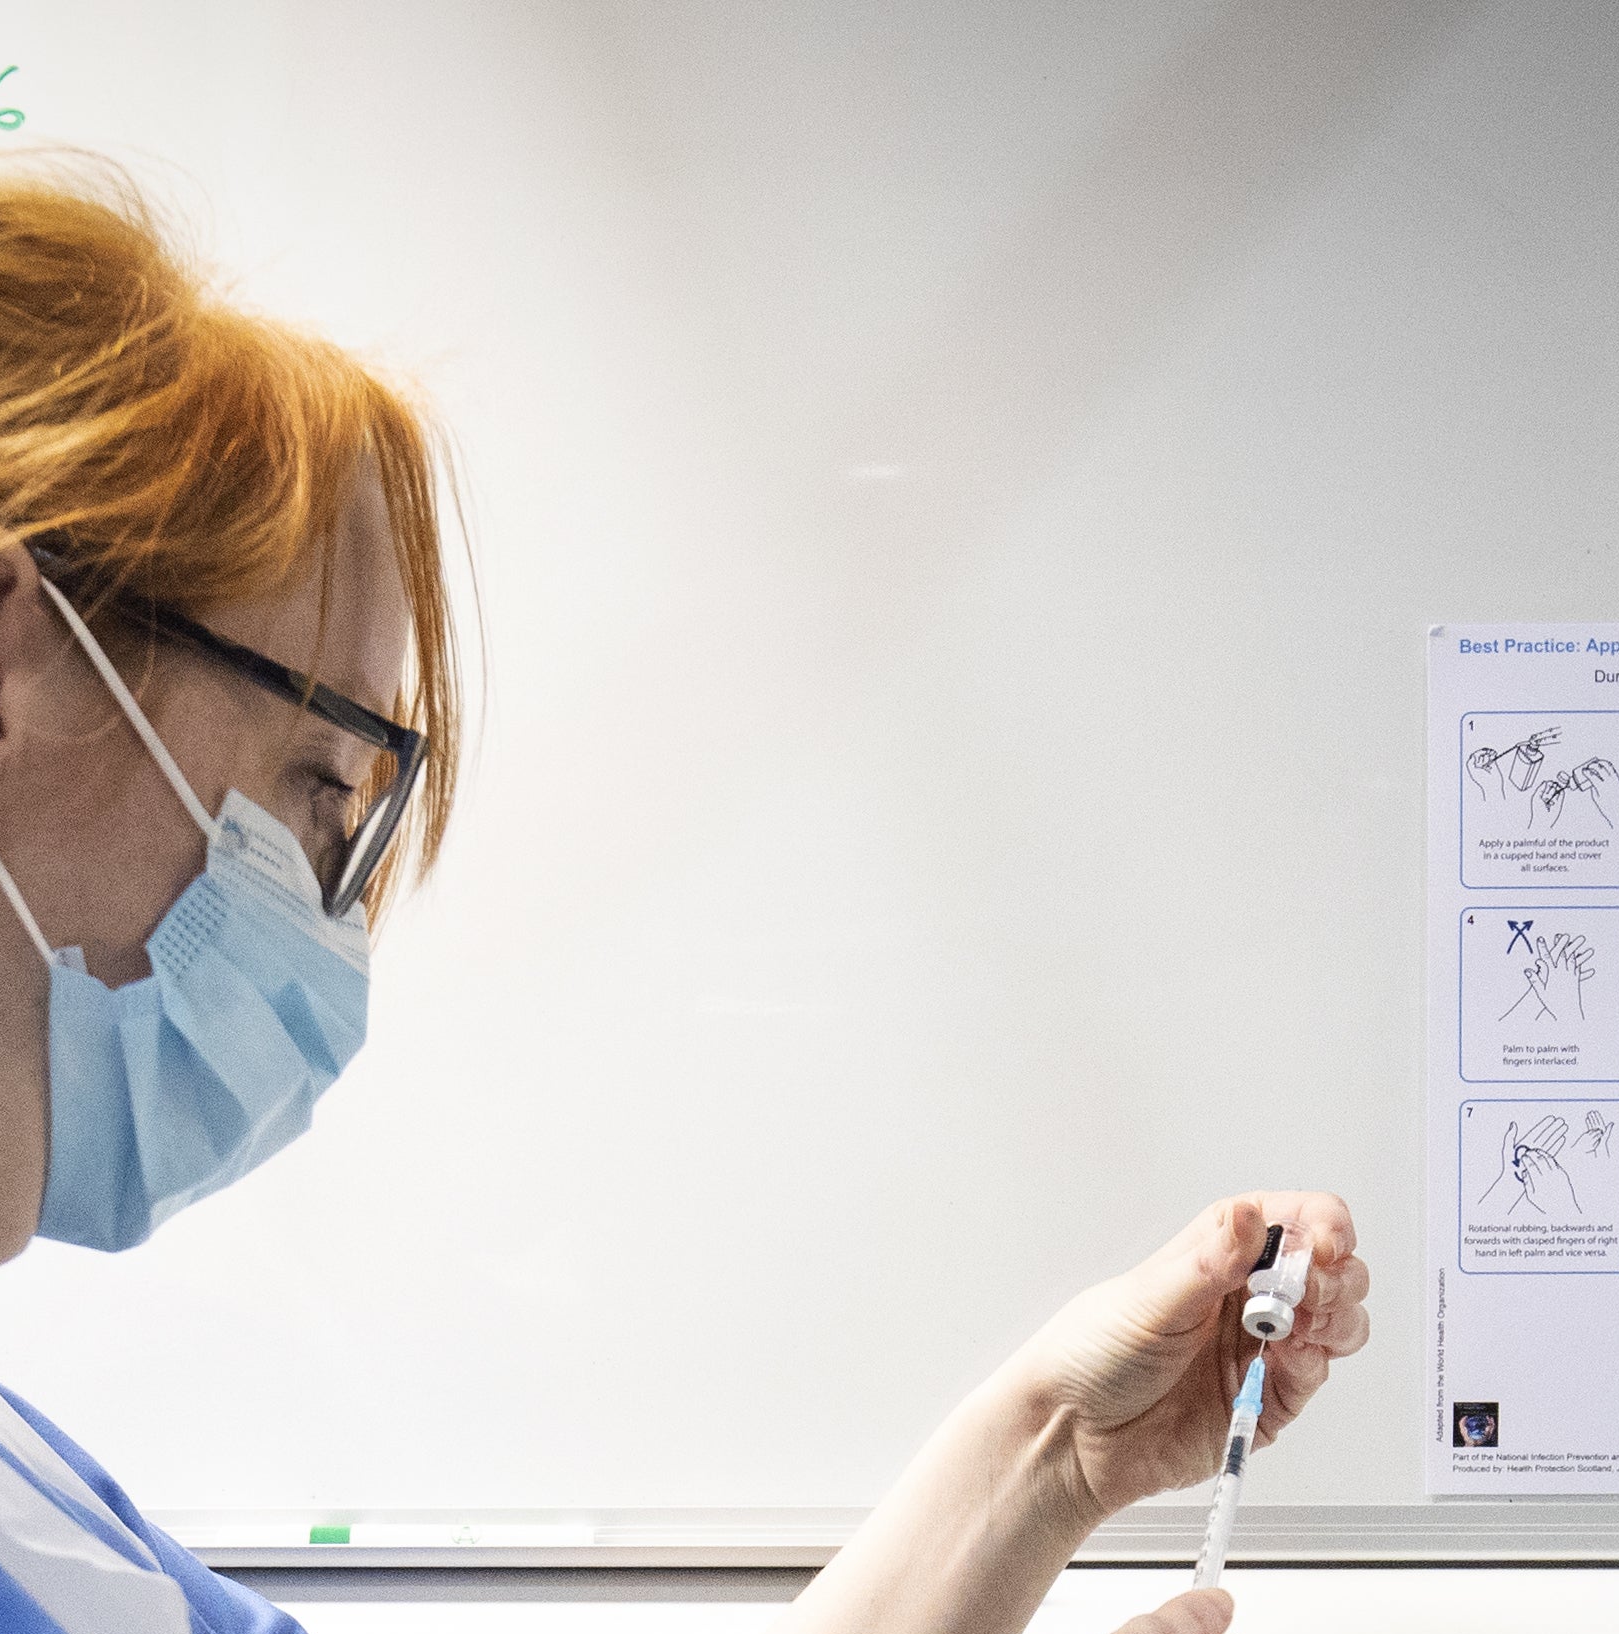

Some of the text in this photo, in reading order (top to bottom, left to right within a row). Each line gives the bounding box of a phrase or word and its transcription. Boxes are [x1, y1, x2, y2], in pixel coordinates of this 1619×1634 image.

[1458, 638, 1500, 655] Best
[1503, 638, 1581, 654] Practice:
[1467, 719, 1475, 732] 1
[1478, 839, 1505, 849] Apply
[1512, 838, 1547, 849] palmful
[1547, 838, 1558, 848] of
[1558, 838, 1574, 847] the
[1574, 838, 1610, 849] product
[1482, 852, 1492, 860] in
[1500, 851, 1534, 862] cupped
[1535, 851, 1559, 860] hand
[1559, 851, 1577, 860] and
[1577, 852, 1602, 860] cover
[1520, 863, 1532, 873] all
[1466, 914, 1476, 926] 4
[1502, 1044, 1580, 1055] Palm to palm with
[1502, 1056, 1533, 1068] fingers
[1466, 1106, 1474, 1119] 7
